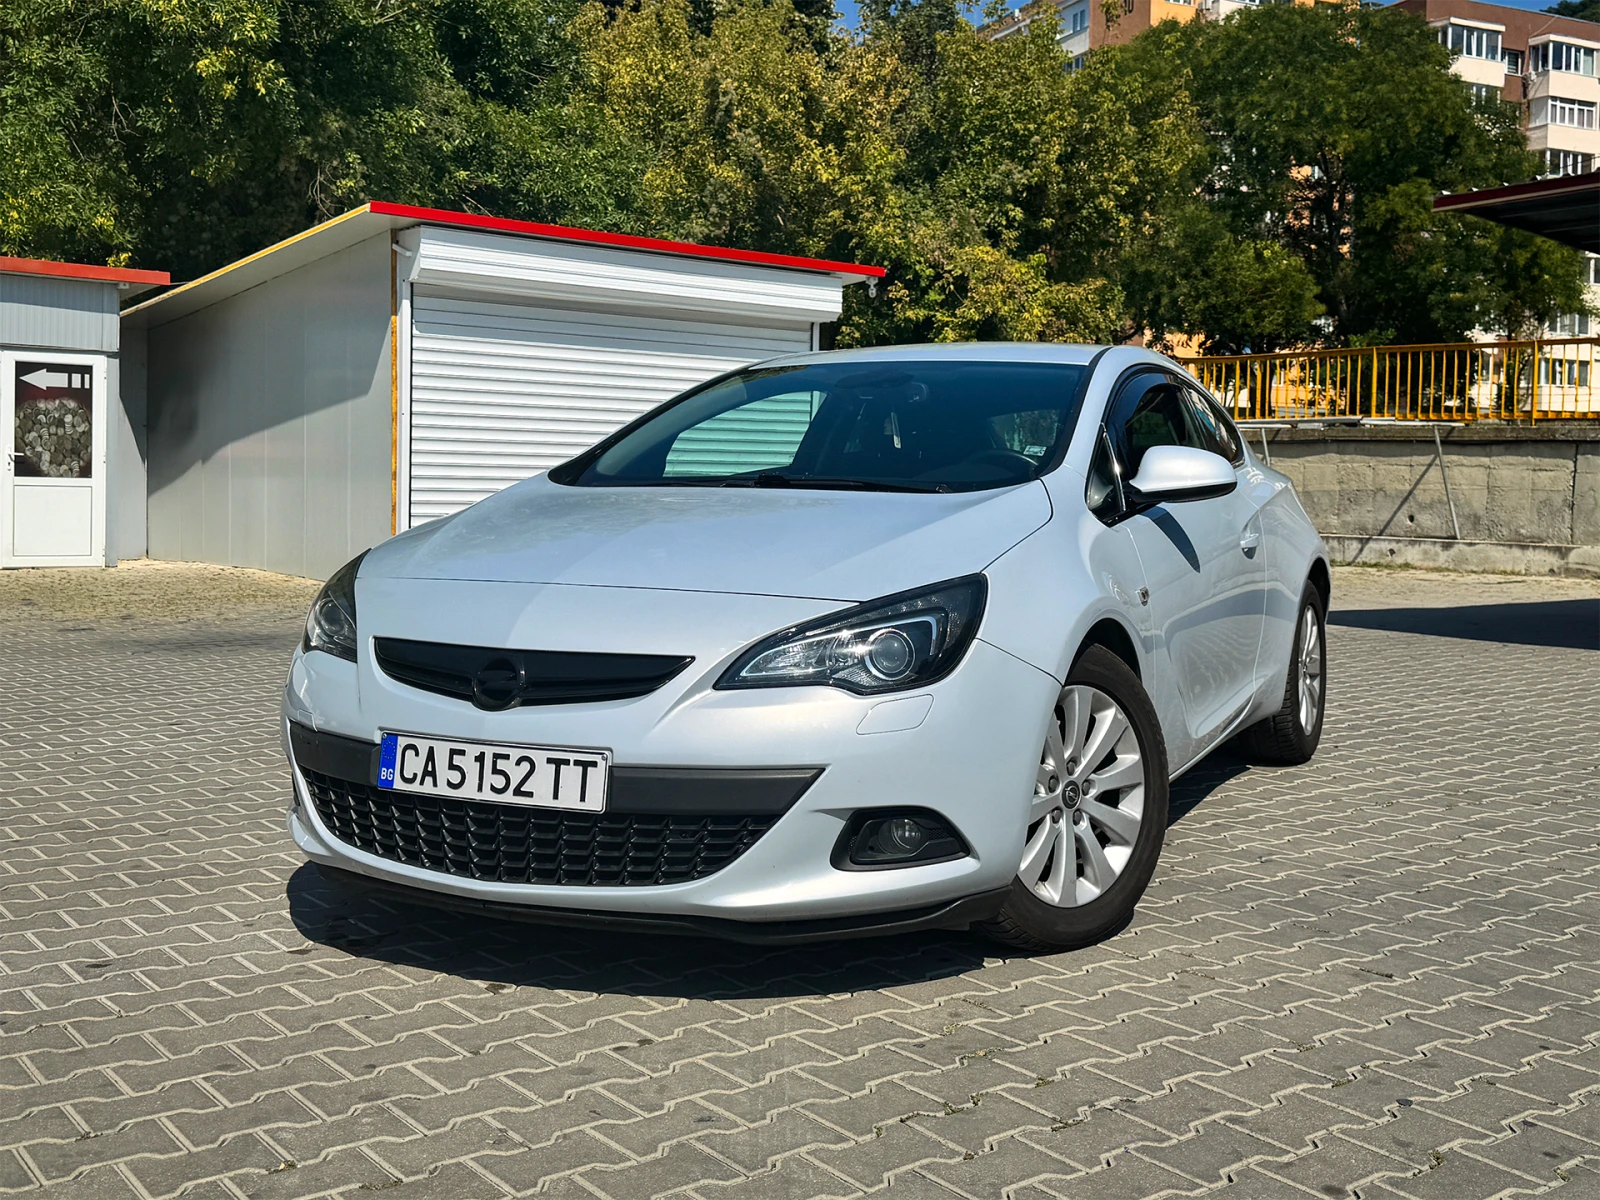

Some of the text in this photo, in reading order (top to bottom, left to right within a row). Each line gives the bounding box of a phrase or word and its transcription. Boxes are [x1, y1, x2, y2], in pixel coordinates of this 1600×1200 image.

[381, 767, 394, 780] BG
[400, 743, 598, 802] CA 5152 TT
